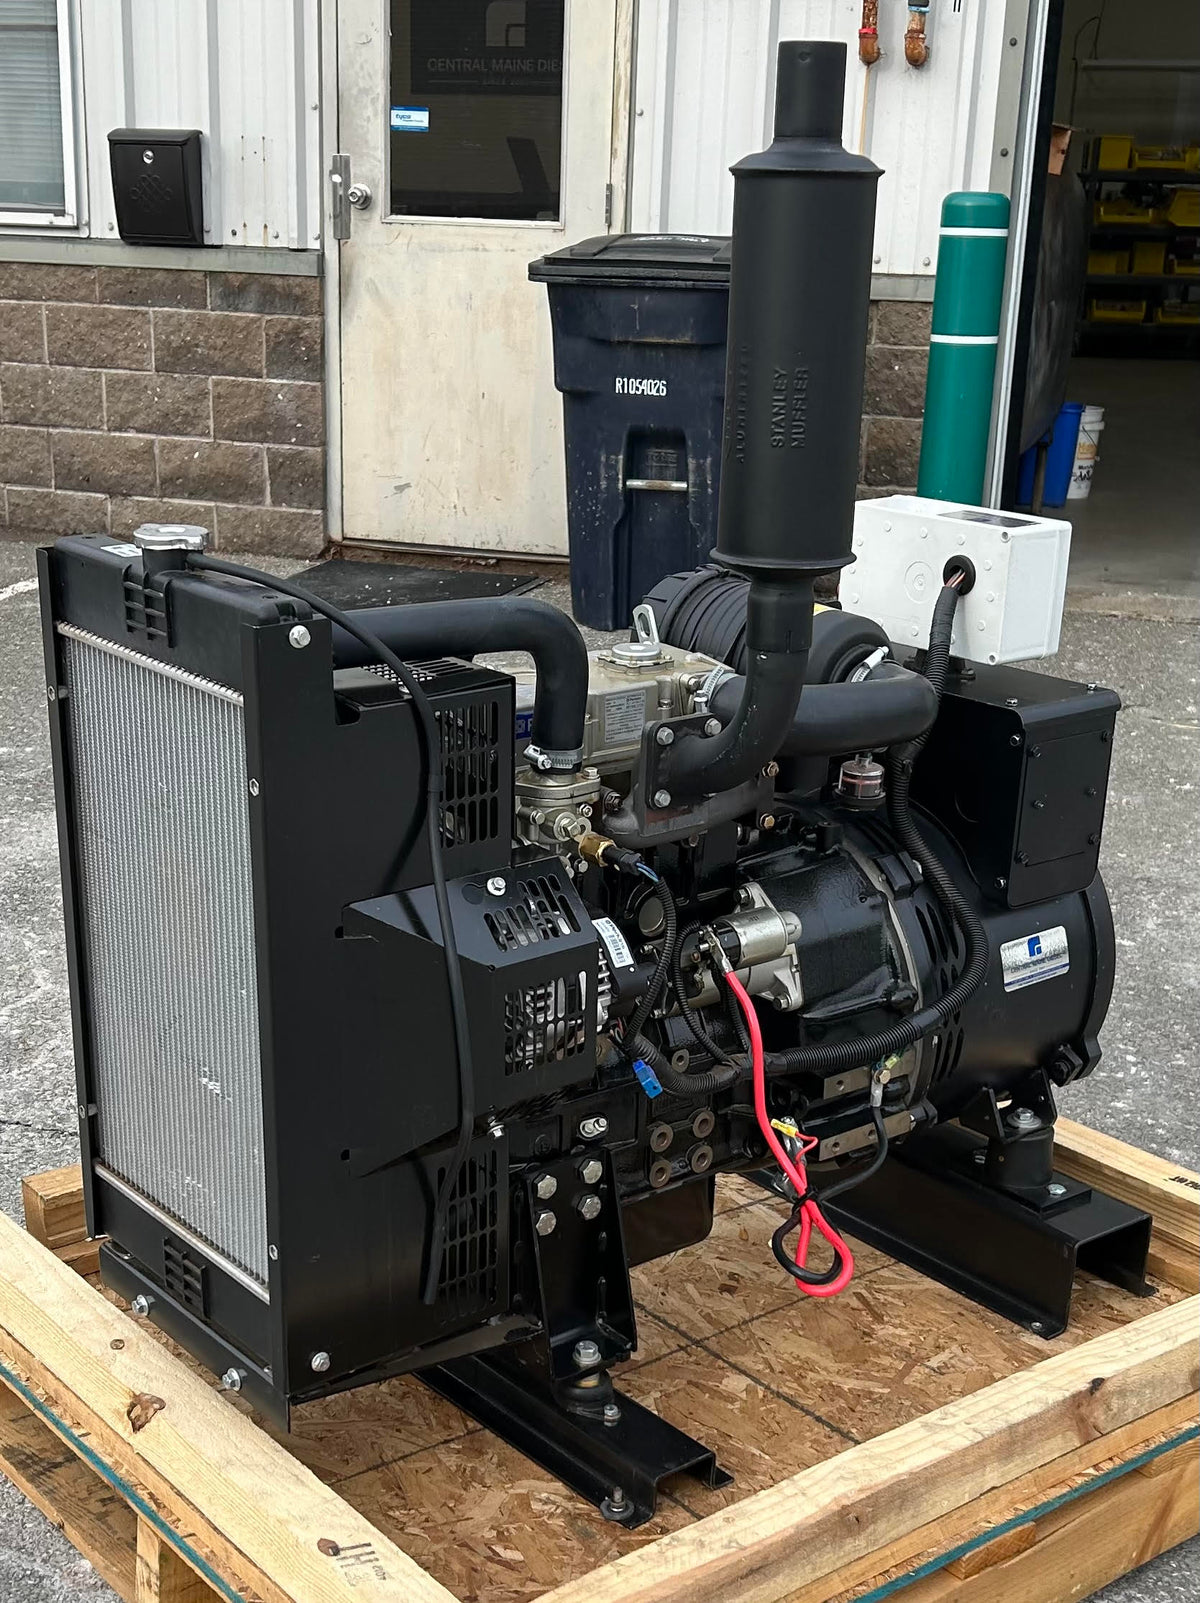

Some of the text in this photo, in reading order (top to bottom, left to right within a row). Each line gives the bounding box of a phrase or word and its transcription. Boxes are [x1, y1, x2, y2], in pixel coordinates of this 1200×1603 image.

[427, 57, 561, 73] CENTRAL MAINE DIE
[615, 377, 667, 397] R1054026
[770, 367, 788, 449] STANLEY
[790, 367, 808, 449] MUFFLER
